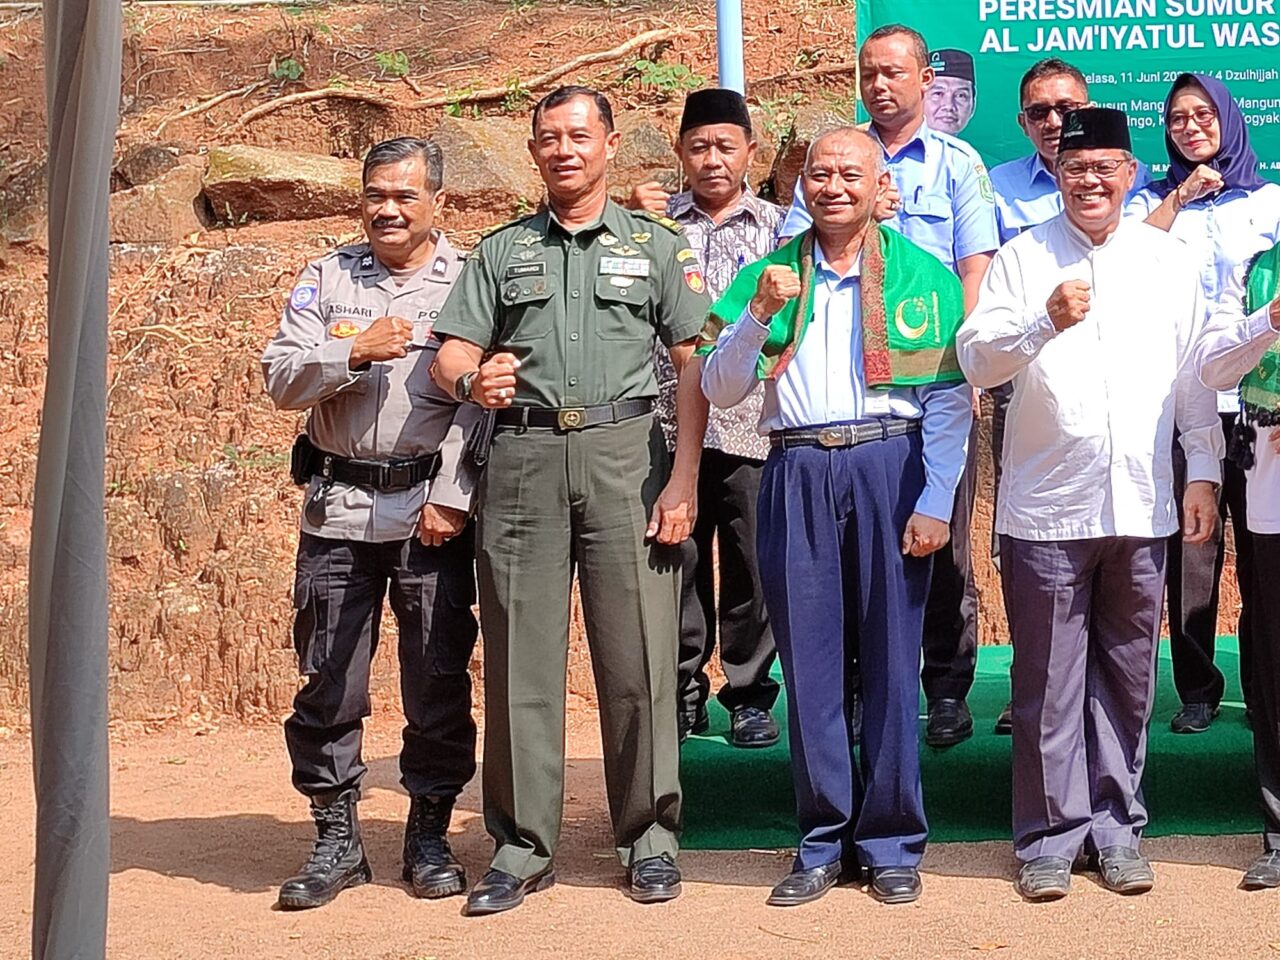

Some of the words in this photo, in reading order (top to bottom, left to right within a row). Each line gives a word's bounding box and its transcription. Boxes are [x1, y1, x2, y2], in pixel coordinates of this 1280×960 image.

[979, 28, 1019, 53] AL
[1027, 24, 1204, 52] JAM'IYATUL
[1082, 72, 1117, 84] elasa,
[1121, 72, 1133, 83] 11
[1136, 71, 1160, 83] Juni
[1225, 68, 1279, 82] Dzulhijjah
[1131, 100, 1164, 113] Mang
[329, 304, 372, 318] ASHARI
